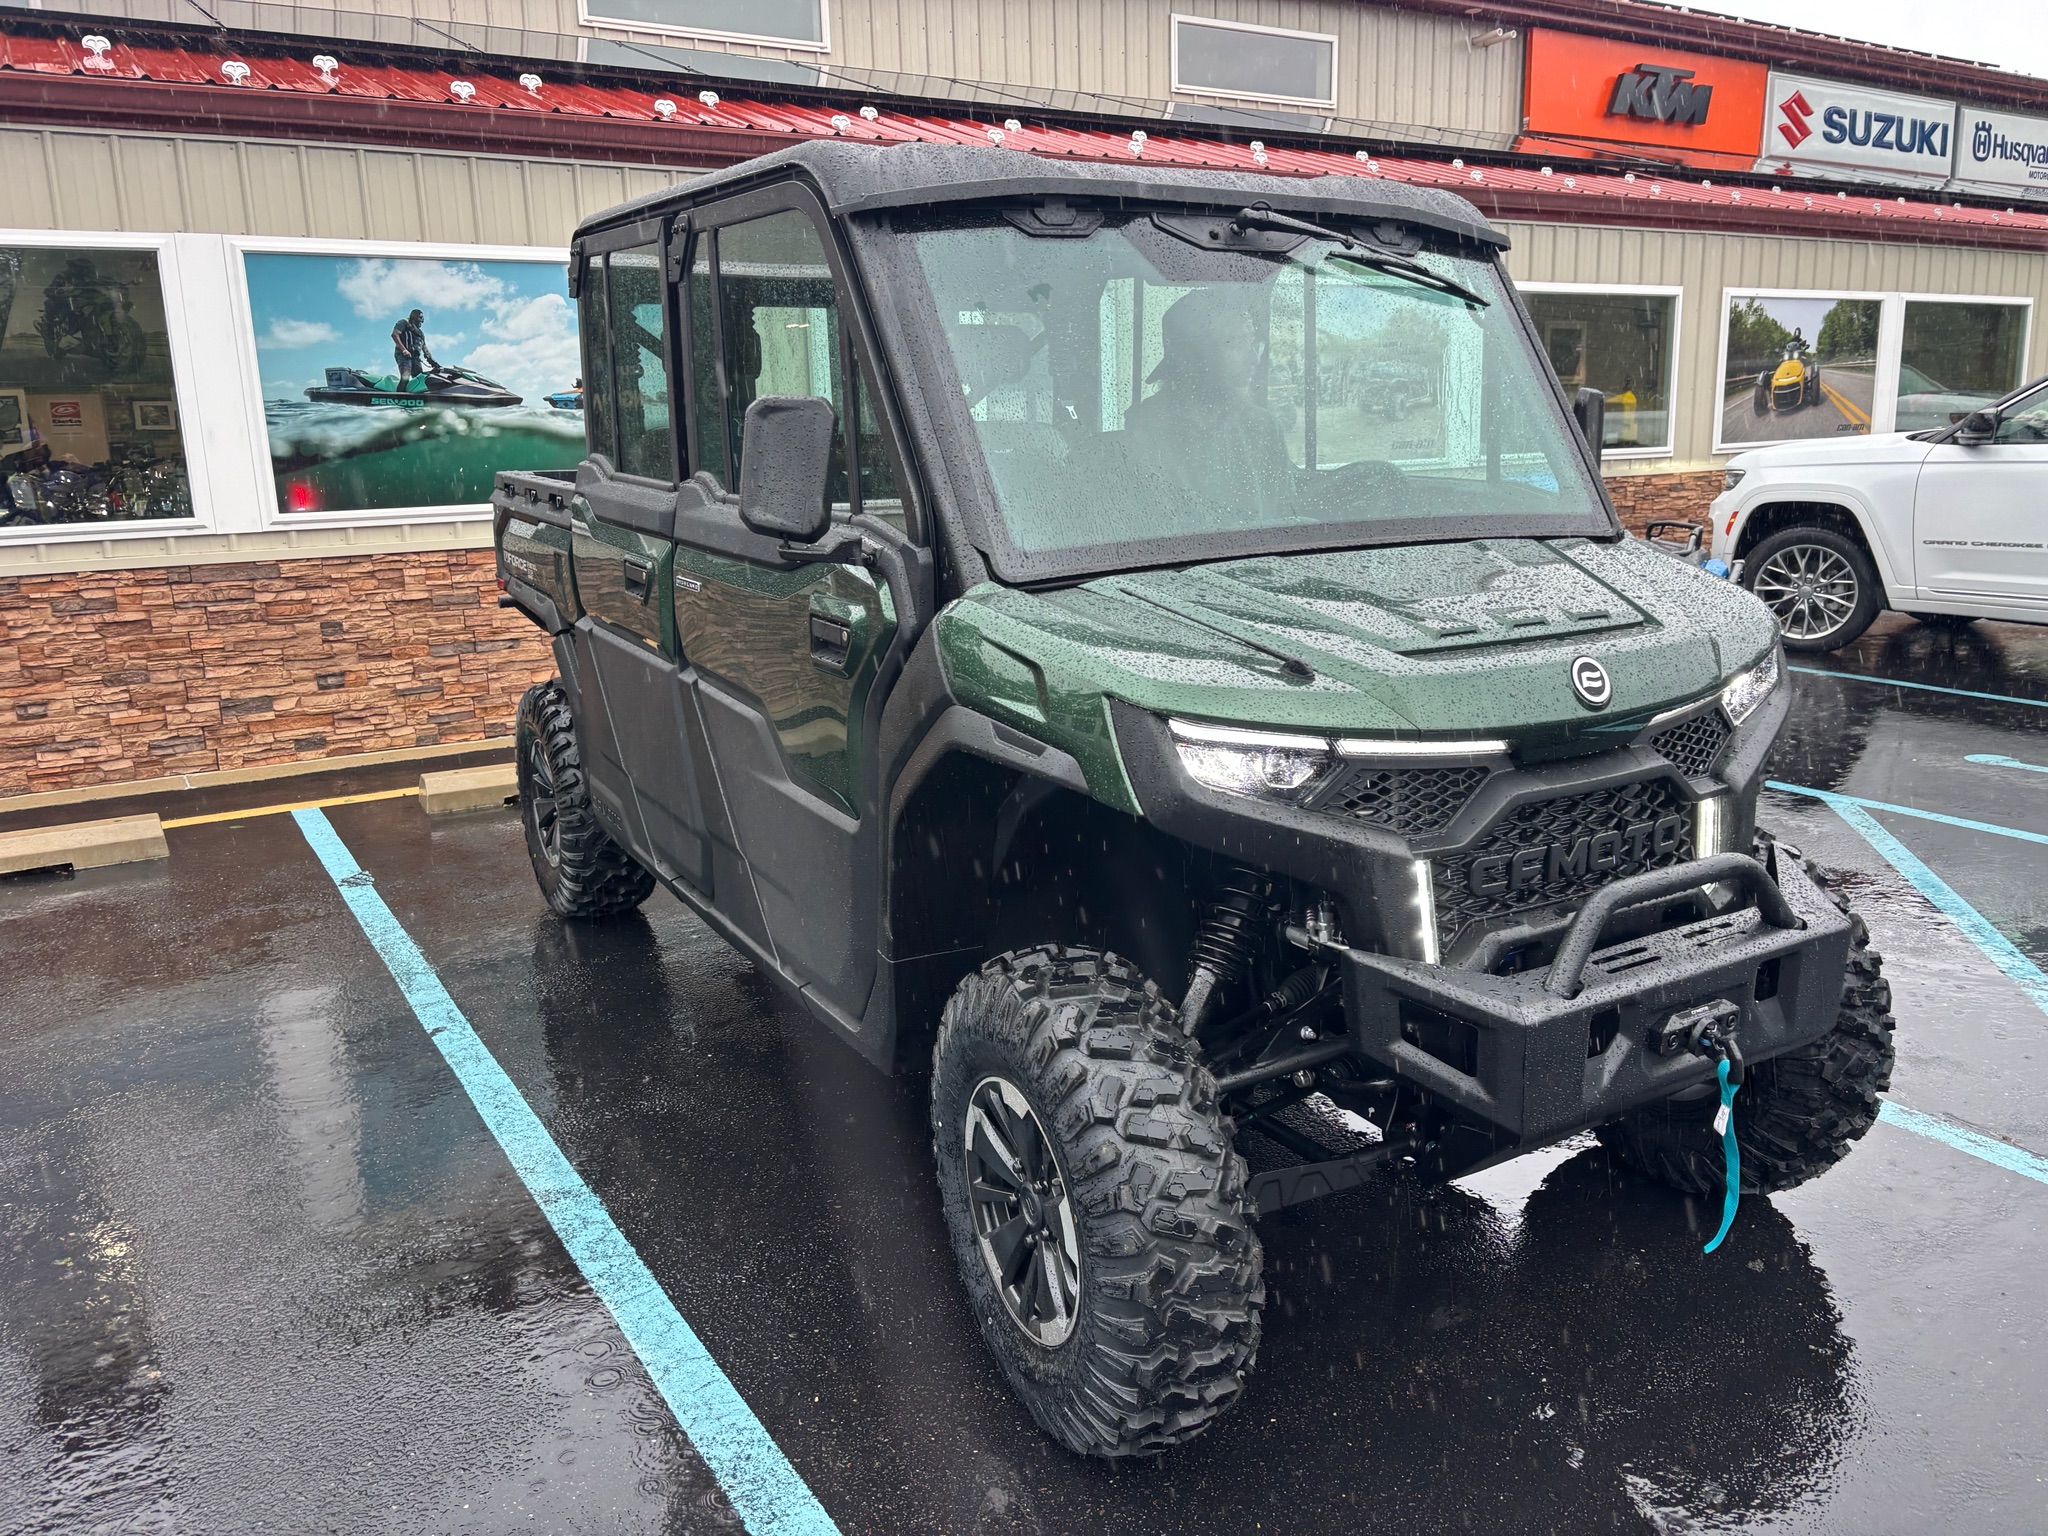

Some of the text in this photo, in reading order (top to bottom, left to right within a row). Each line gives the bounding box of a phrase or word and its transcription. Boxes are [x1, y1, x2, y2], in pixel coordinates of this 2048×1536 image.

[1606, 63, 1714, 126] KTM
[1822, 105, 1949, 158] SUZUKI
[1970, 541, 2044, 549] CHEROKEE
[1469, 814, 1682, 897] CFMOTO
